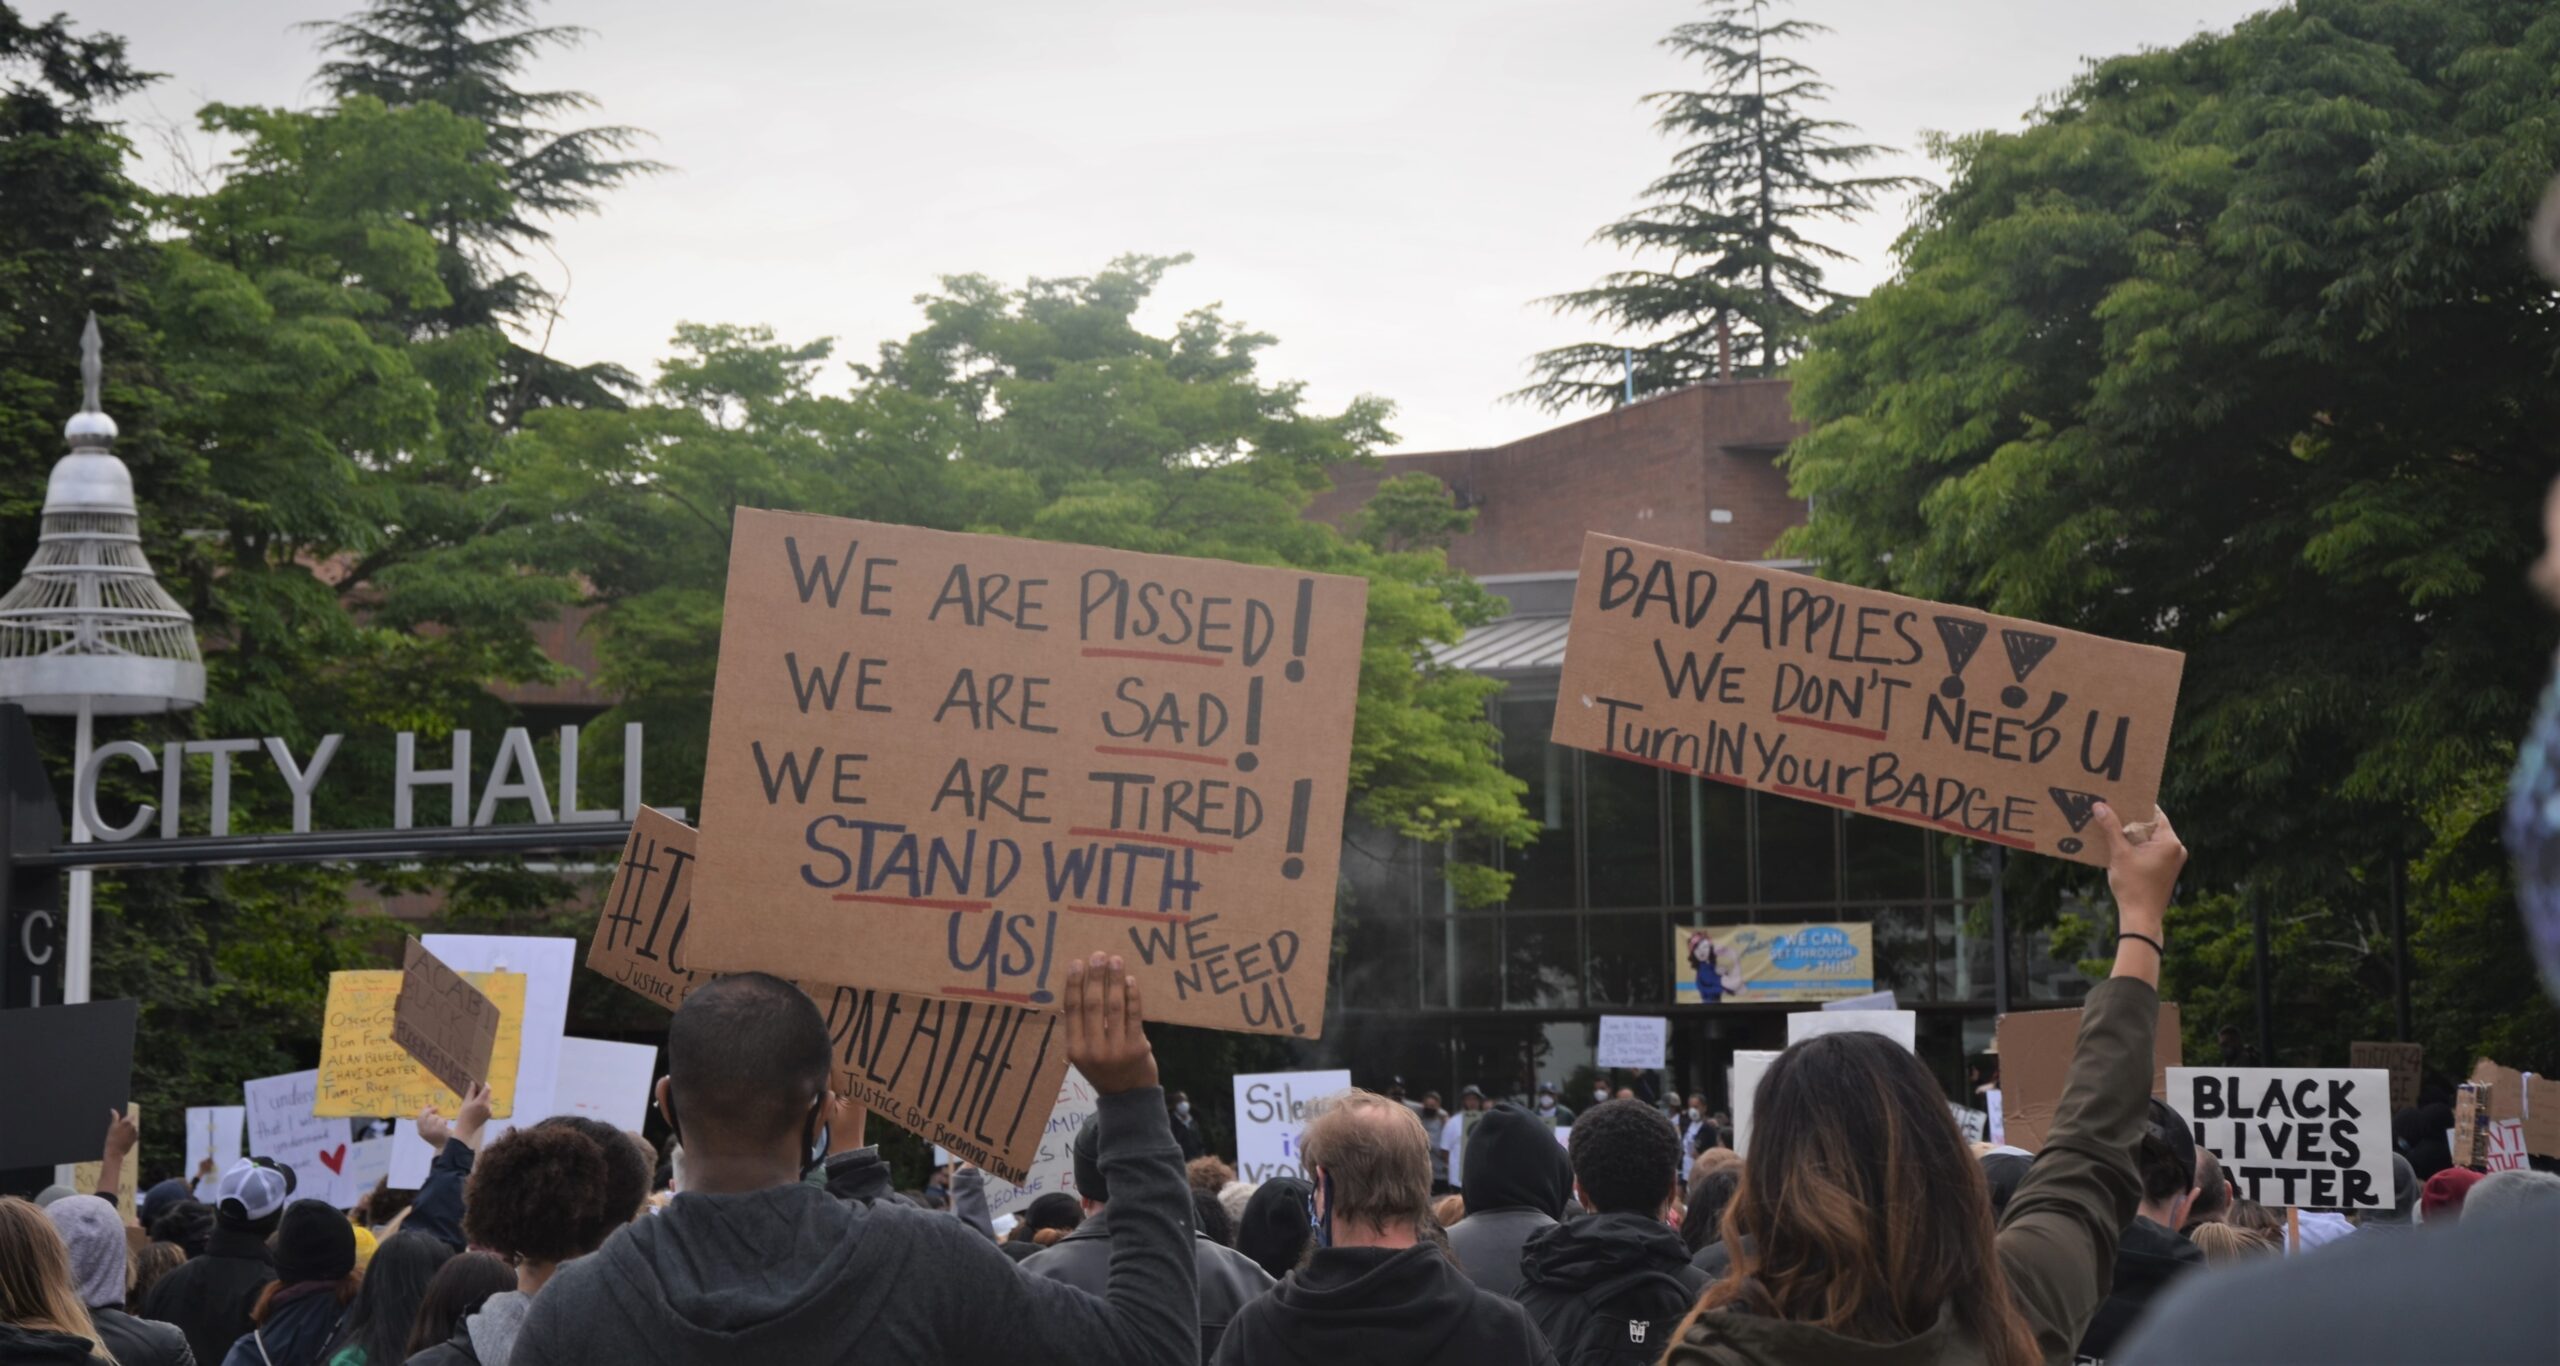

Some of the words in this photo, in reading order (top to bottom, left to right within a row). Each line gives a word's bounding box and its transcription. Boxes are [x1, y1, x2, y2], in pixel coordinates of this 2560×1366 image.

[784, 535, 898, 617] WE
[928, 564, 1049, 632] ARE
[1081, 568, 1314, 683] PISSED!
[1600, 547, 1717, 629] BAD
[784, 651, 893, 714] WE
[933, 667, 1059, 733] ARE
[1101, 675, 1264, 773] SAD!
[1773, 662, 1912, 731] DON'T
[2080, 709, 2130, 782] U
[78, 733, 344, 842] CITY
[394, 721, 687, 829] HALL
[752, 740, 868, 805] WE
[930, 757, 1052, 823] ARE
[800, 814, 1022, 898] STAND
[1042, 840, 1204, 912] WITH
[947, 909, 1058, 1004] US!
[1128, 913, 1230, 966] WE
[1173, 929, 1300, 1000] NEED
[1784, 932, 1809, 946] WE
[1811, 932, 1844, 946] CAN
[1794, 948, 1853, 960] THROUGH
[615, 958, 676, 1004] Justice
[1239, 975, 1306, 1035] U!
[374, 1064, 420, 1078] CARTER
[841, 1070, 902, 1120] Justice
[906, 1106, 933, 1130] for
[2192, 1075, 2363, 1121] BLACK
[2193, 1118, 2362, 1170] LIVES
[2221, 1165, 2381, 1208] ATTER
